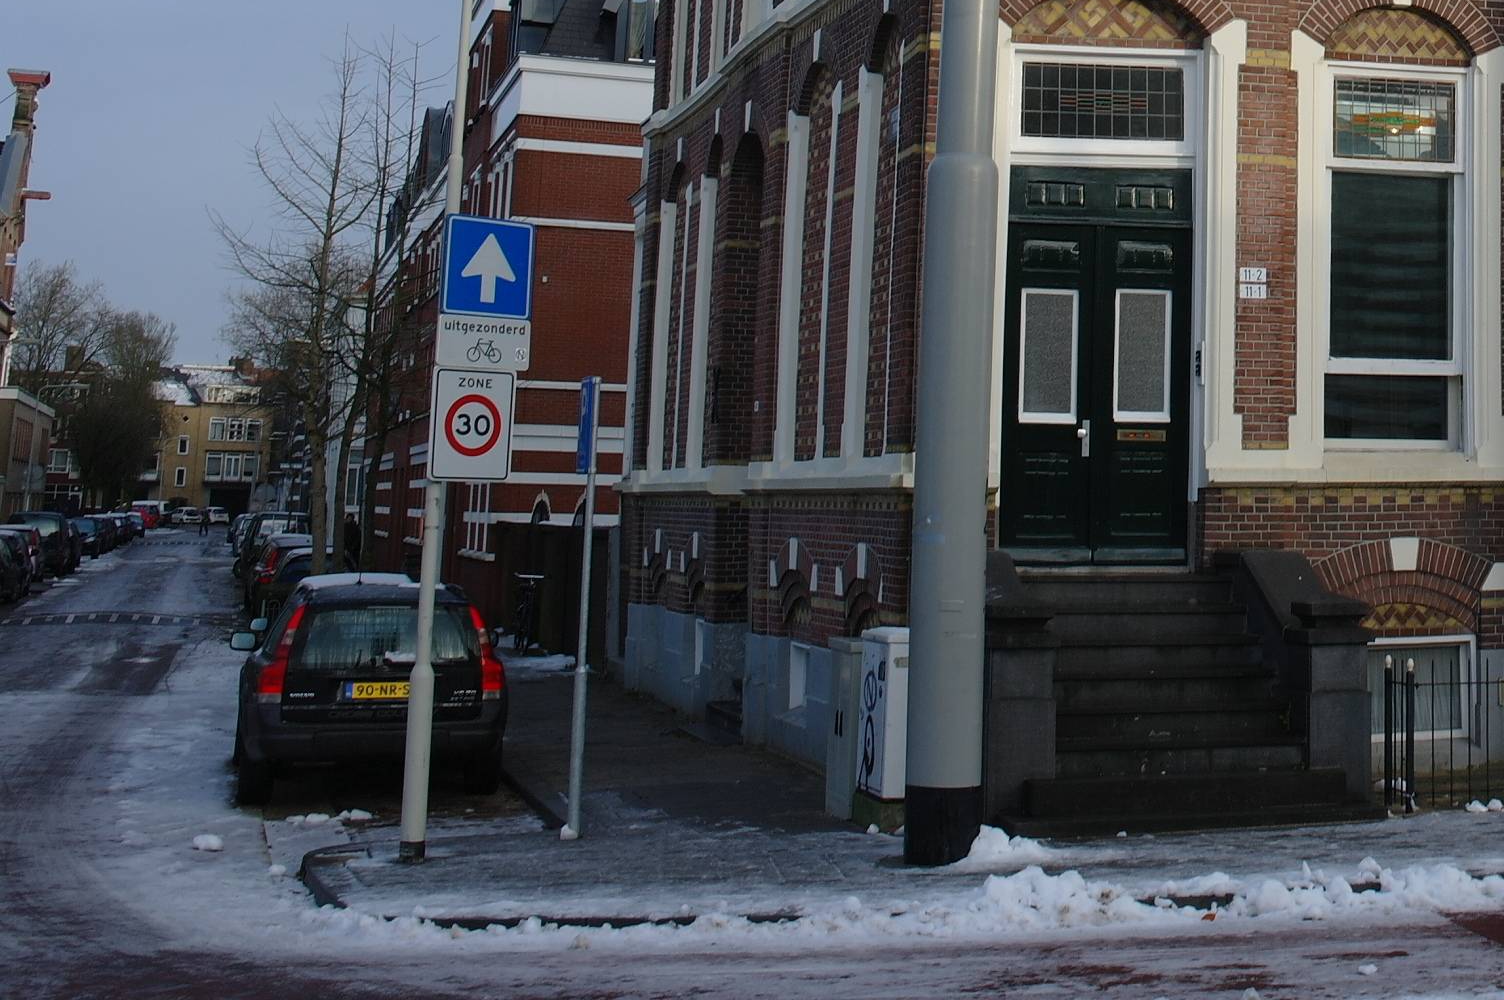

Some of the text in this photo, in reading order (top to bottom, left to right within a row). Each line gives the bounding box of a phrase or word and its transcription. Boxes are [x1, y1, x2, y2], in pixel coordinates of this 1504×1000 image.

[444, 319, 526, 335] uitgezonderd
[458, 377, 493, 389] ZONE
[455, 413, 491, 436] 30
[356, 684, 410, 697] 90-NR-S
